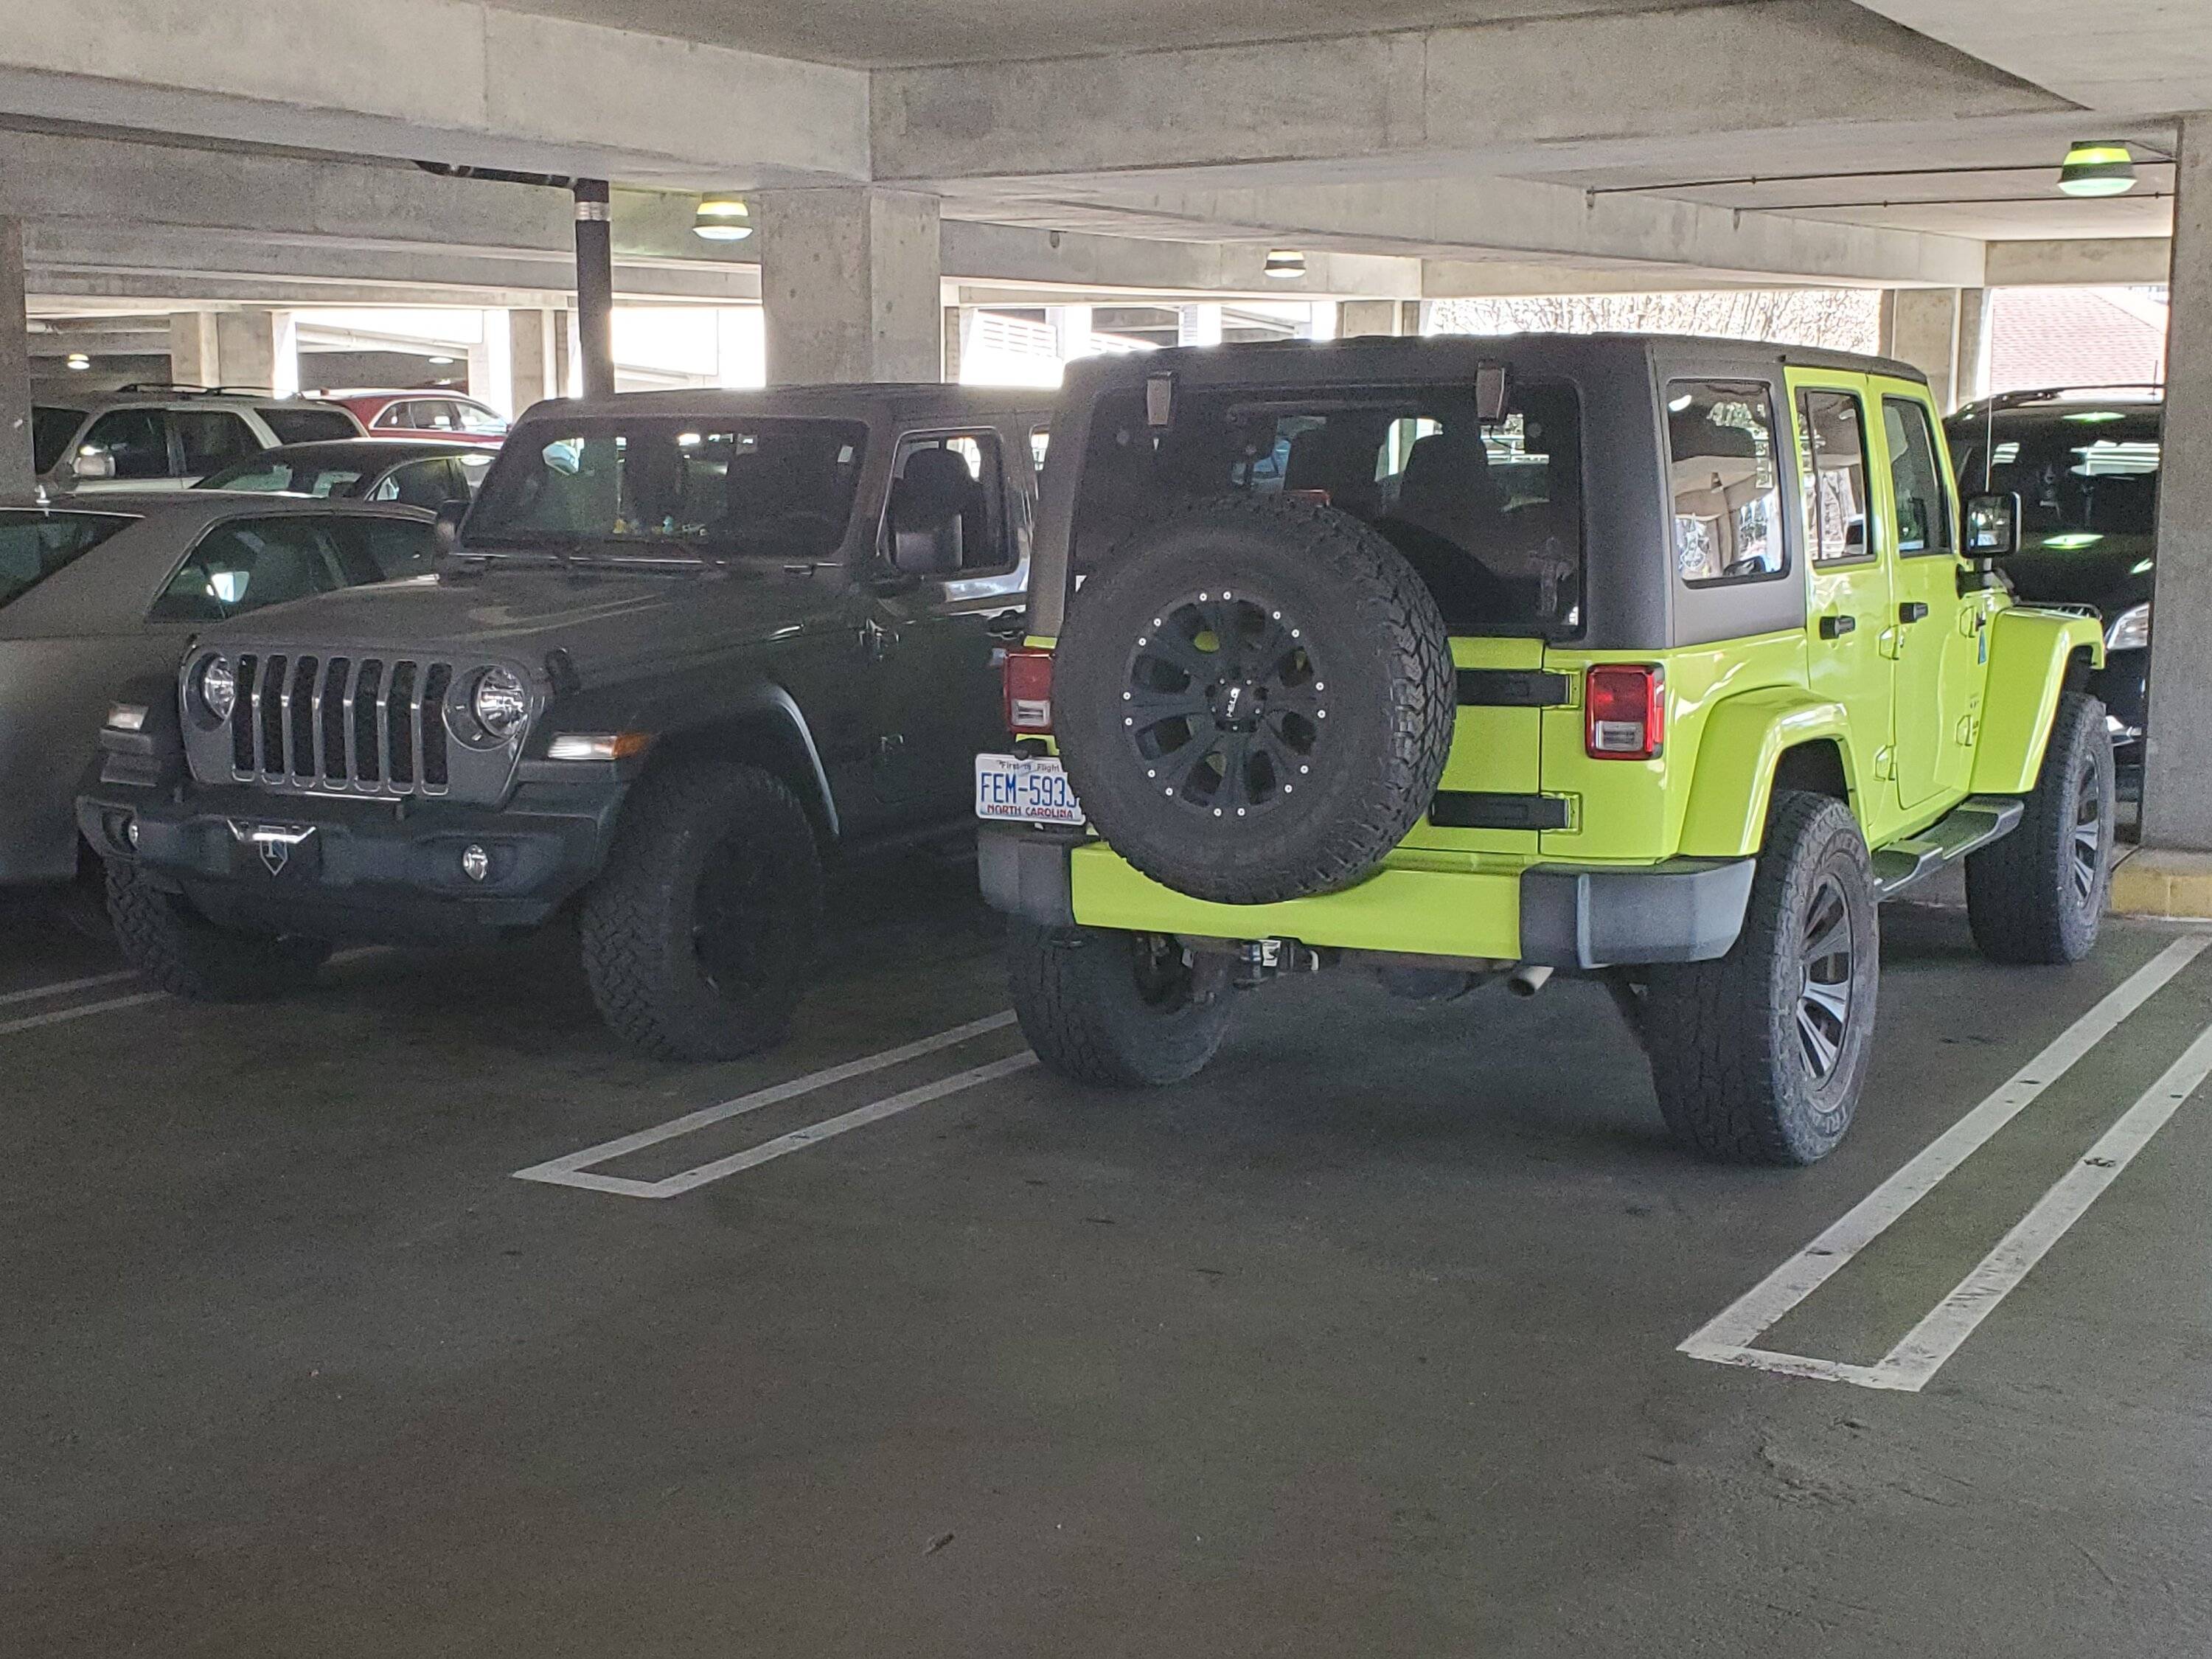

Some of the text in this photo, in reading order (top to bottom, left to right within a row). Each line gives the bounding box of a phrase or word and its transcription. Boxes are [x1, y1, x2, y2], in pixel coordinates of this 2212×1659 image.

[1037, 763, 1061, 773] Flight
[987, 804, 1074, 819] NORTH CAROLINA
